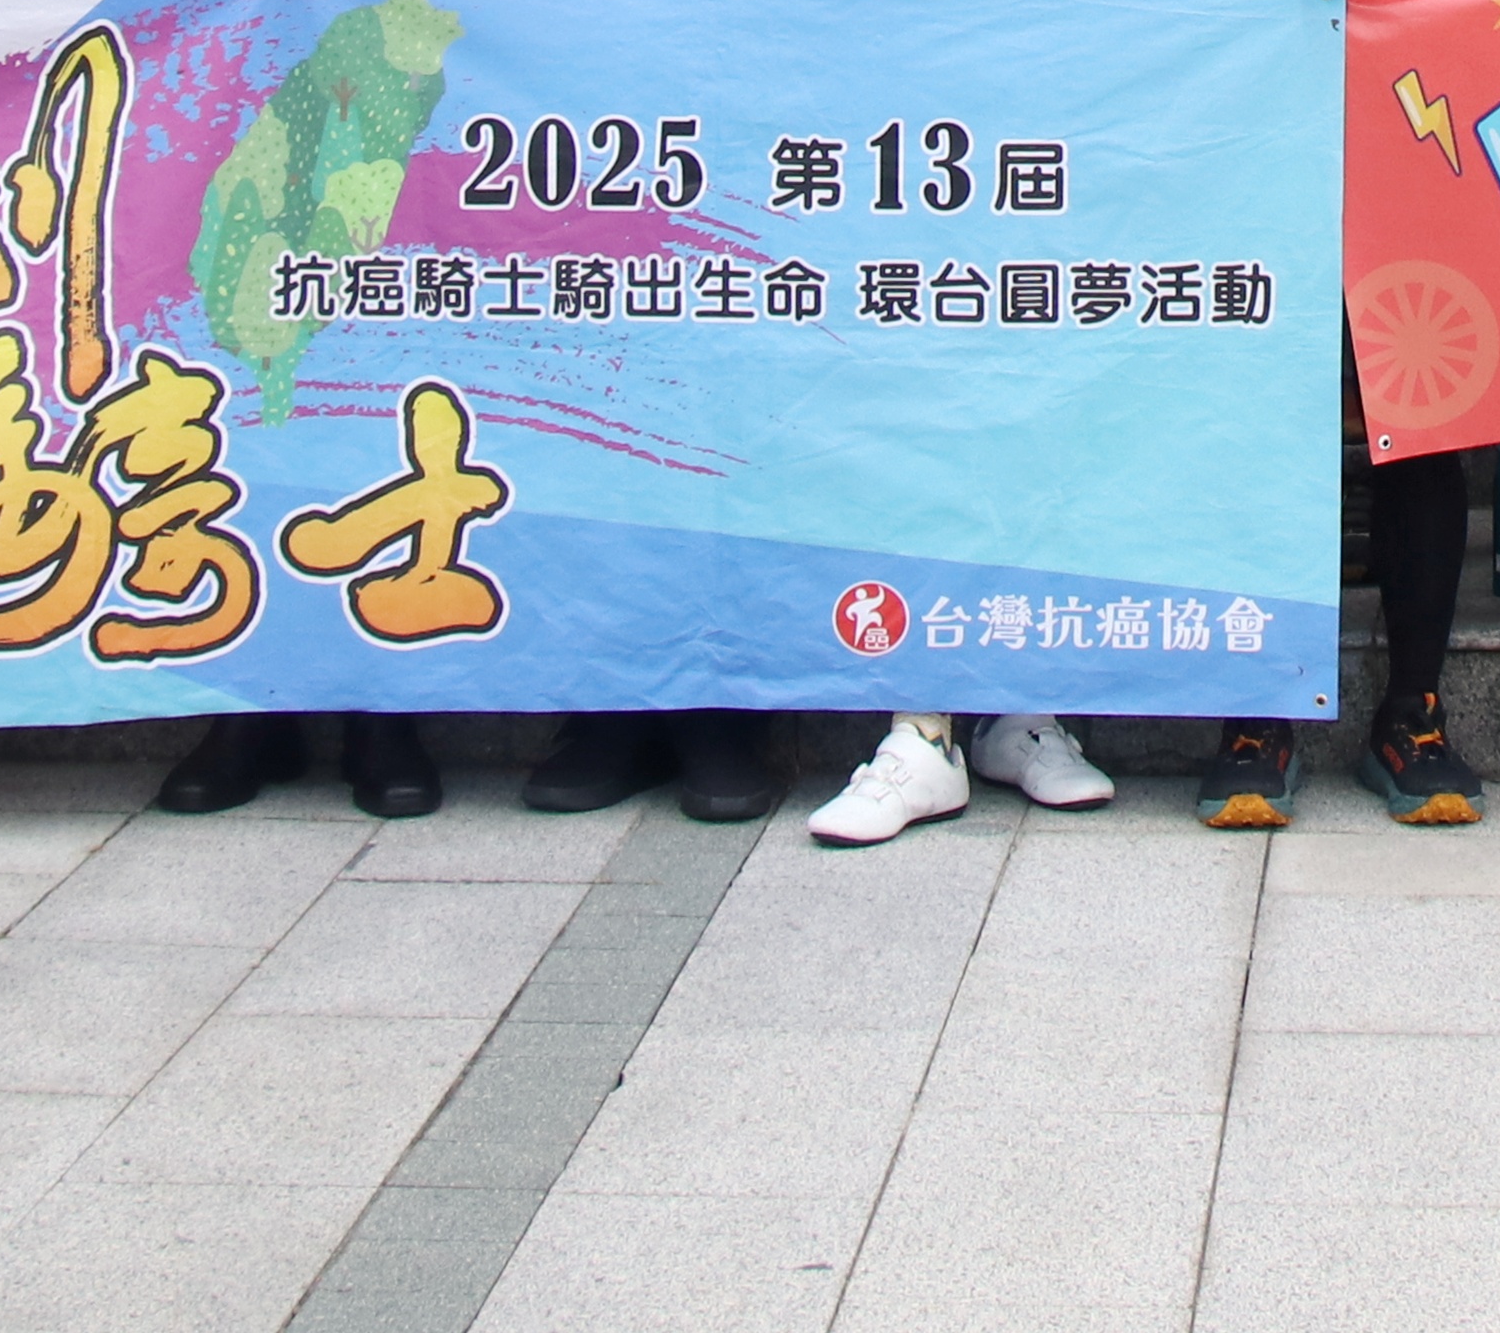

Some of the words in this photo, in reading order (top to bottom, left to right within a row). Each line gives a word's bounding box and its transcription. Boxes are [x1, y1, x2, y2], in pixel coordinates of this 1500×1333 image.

[461, 115, 704, 211] 2025
[271, 253, 826, 323] 抗癌騎士騎出生命
[858, 261, 1274, 329] 環台圓夢活動
[922, 594, 1274, 655] 台灣抗癌協會
